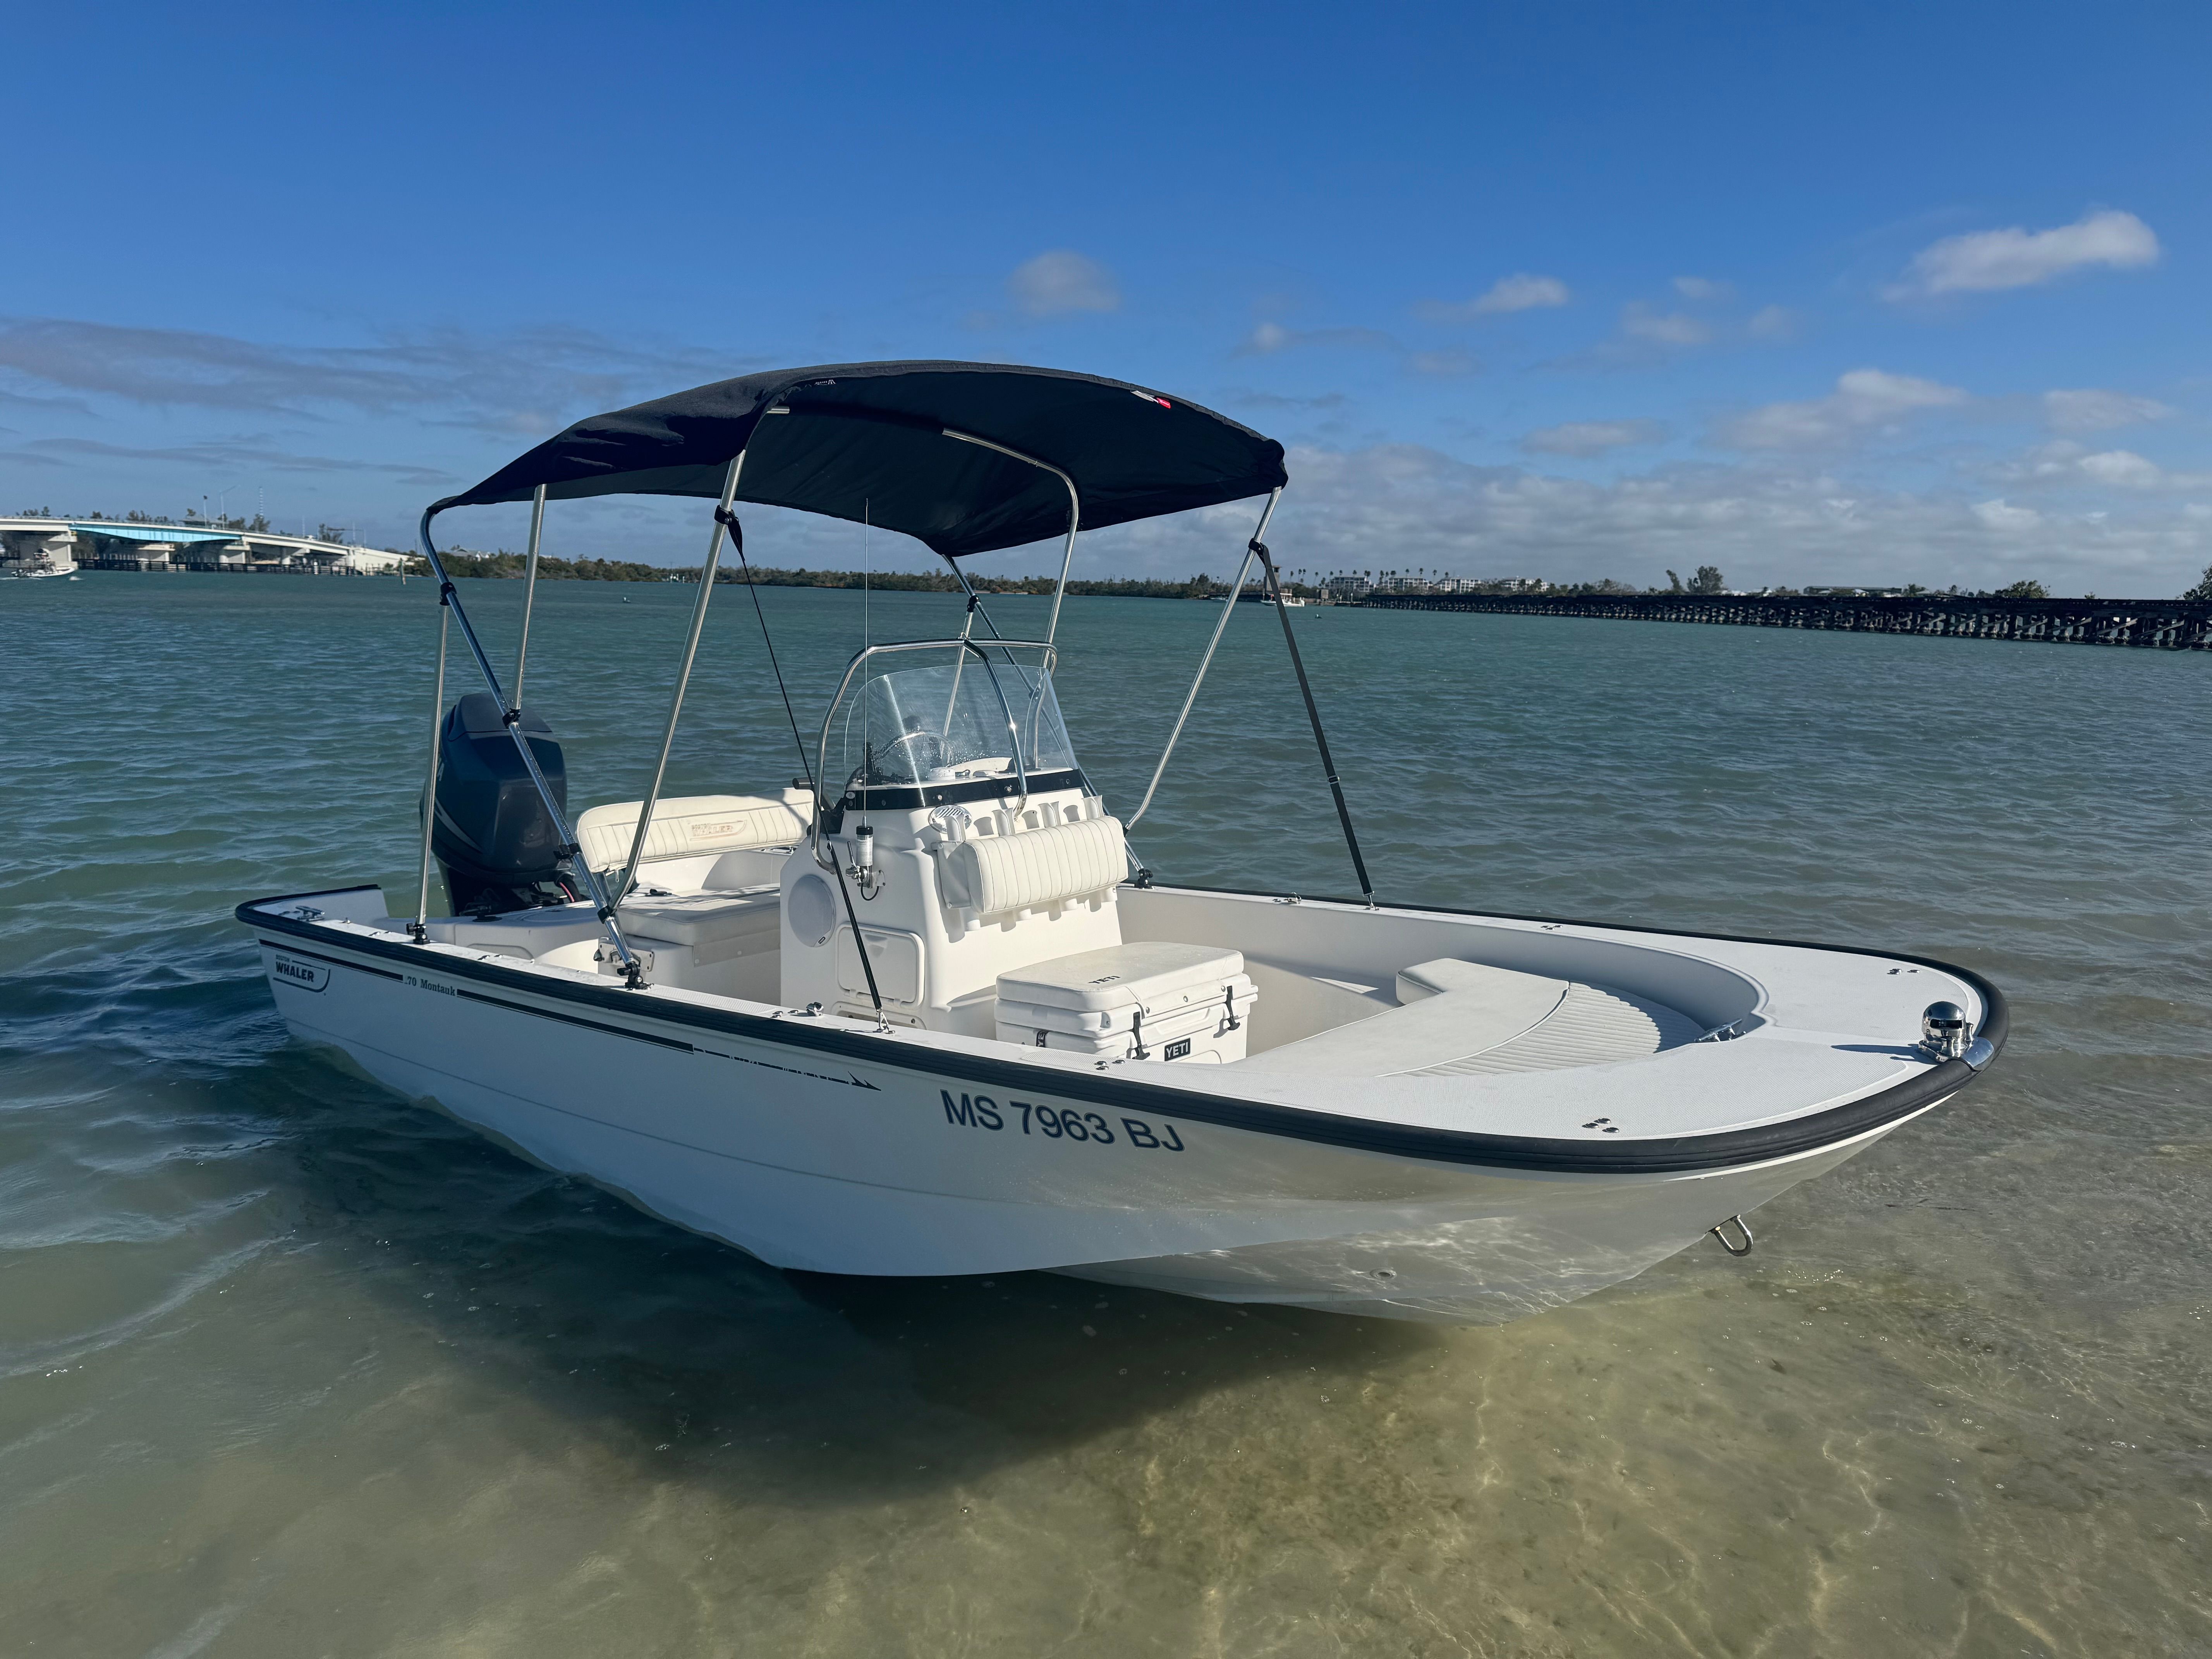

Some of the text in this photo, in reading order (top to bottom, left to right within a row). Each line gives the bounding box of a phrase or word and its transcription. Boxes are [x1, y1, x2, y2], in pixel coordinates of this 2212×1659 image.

[276, 961, 314, 982] WHALER
[404, 975, 455, 996] 70 Montauk
[1166, 1042, 1188, 1058] YETI
[940, 1089, 1185, 1152] MS 7963 BJ
